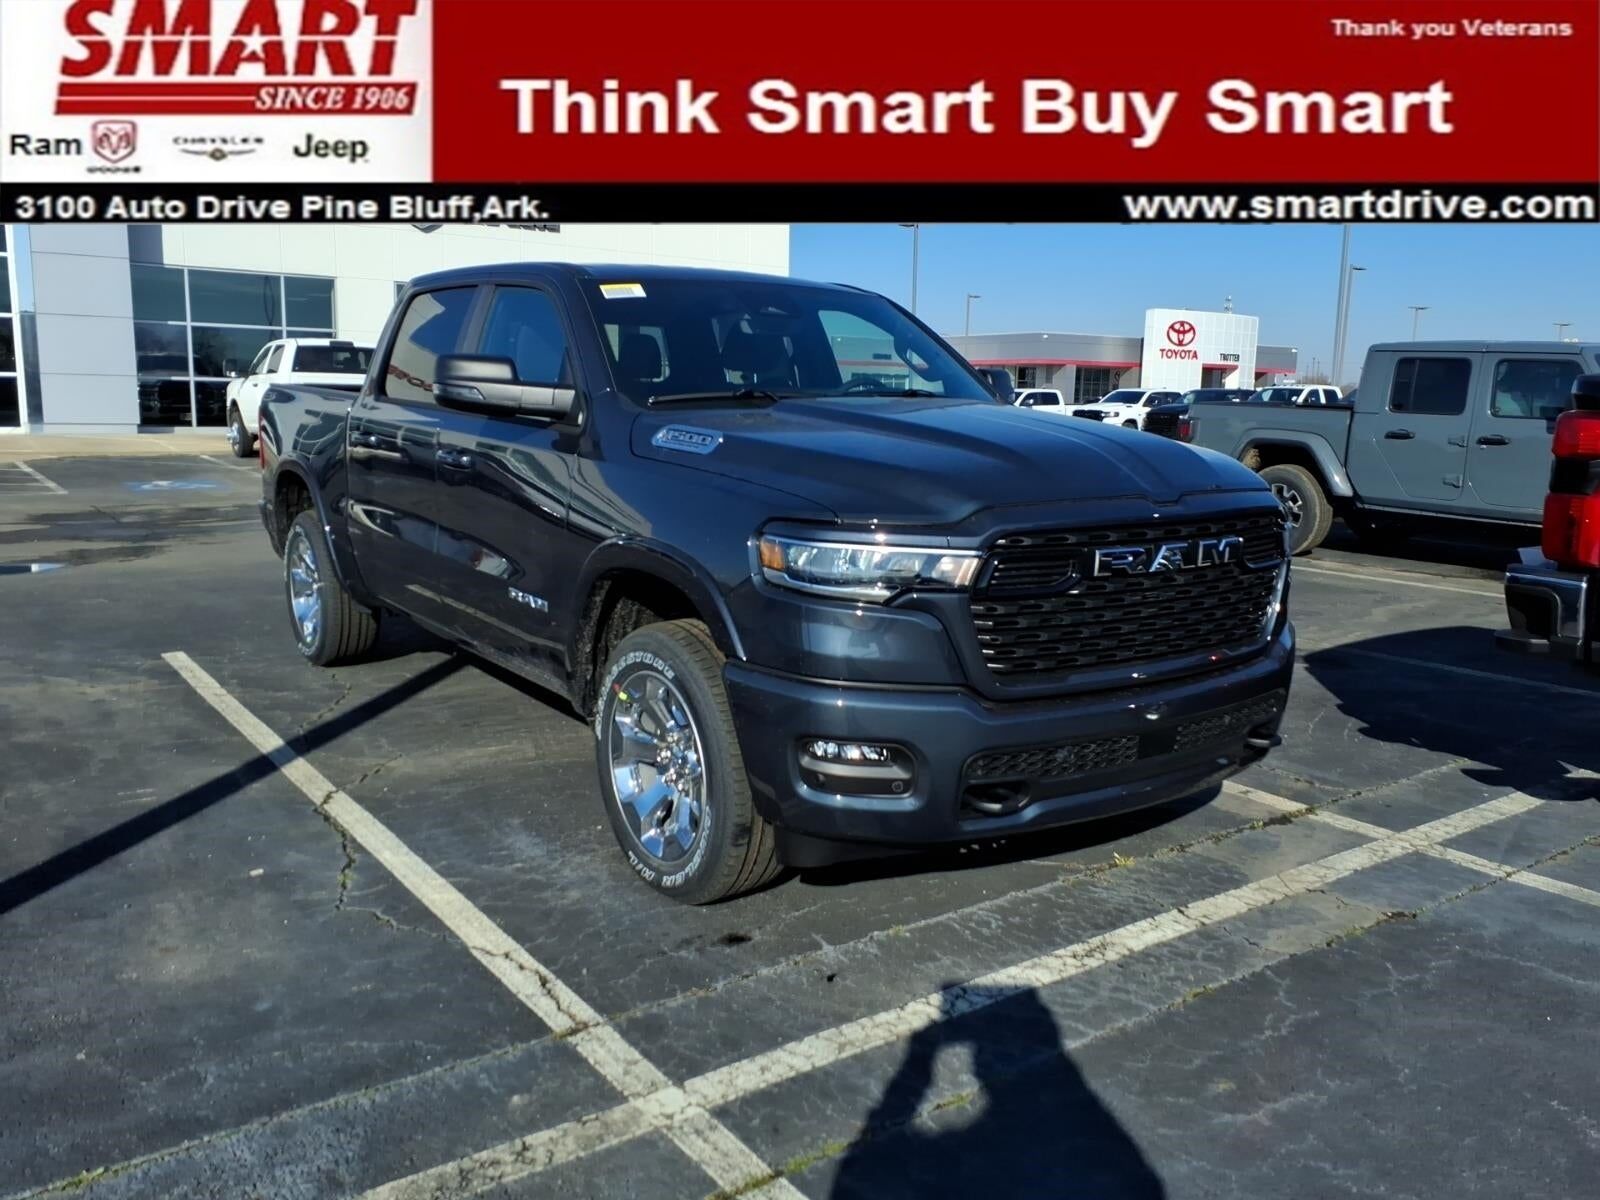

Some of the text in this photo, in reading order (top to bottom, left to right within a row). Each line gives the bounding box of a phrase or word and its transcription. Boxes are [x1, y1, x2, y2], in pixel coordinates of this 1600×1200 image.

[1159, 348, 1199, 360] TOYOTA
[1094, 536, 1244, 577] RAM
[508, 586, 549, 613] RAM
